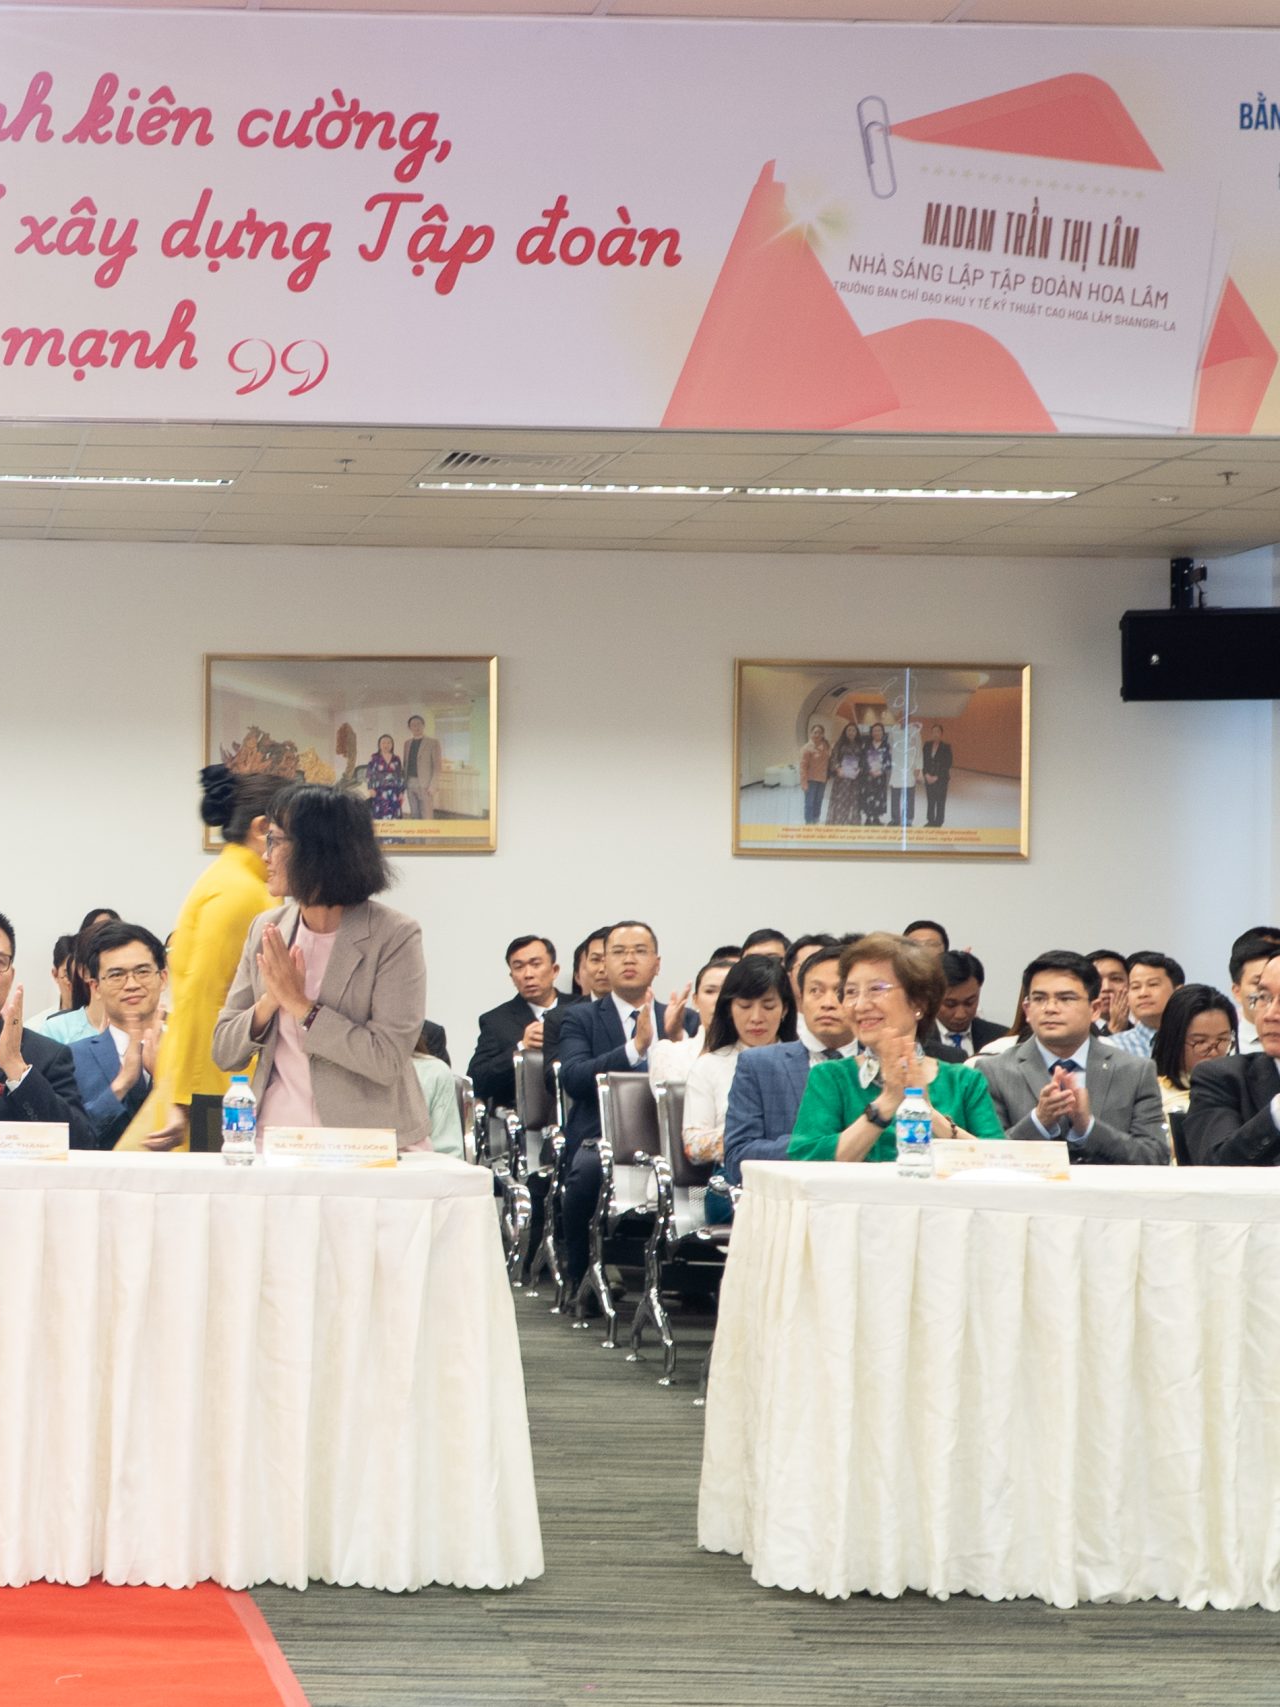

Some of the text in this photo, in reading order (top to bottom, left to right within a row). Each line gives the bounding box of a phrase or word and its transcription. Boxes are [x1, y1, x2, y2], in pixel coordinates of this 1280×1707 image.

[62, 72, 214, 147] kiên
[237, 88, 452, 184] cường,
[15, 196, 138, 288] xây
[161, 188, 332, 293] dựng
[358, 192, 495, 295] Tập
[515, 195, 683, 268] đoàn
[922, 196, 1140, 272] MADAM TRẦN THỊ LÂM
[848, 253, 1169, 310] NHÀ SÁNG LẬP TẬP ĐOÀN HOA LÂM
[877, 286, 898, 298] BAN
[944, 294, 966, 307] KHU
[969, 296, 977, 308] Y
[1045, 306, 1066, 319] CAO
[1067, 309, 1089, 321] HOA
[1091, 310, 1112, 324] LÂM
[1, 299, 198, 382] mạnh
